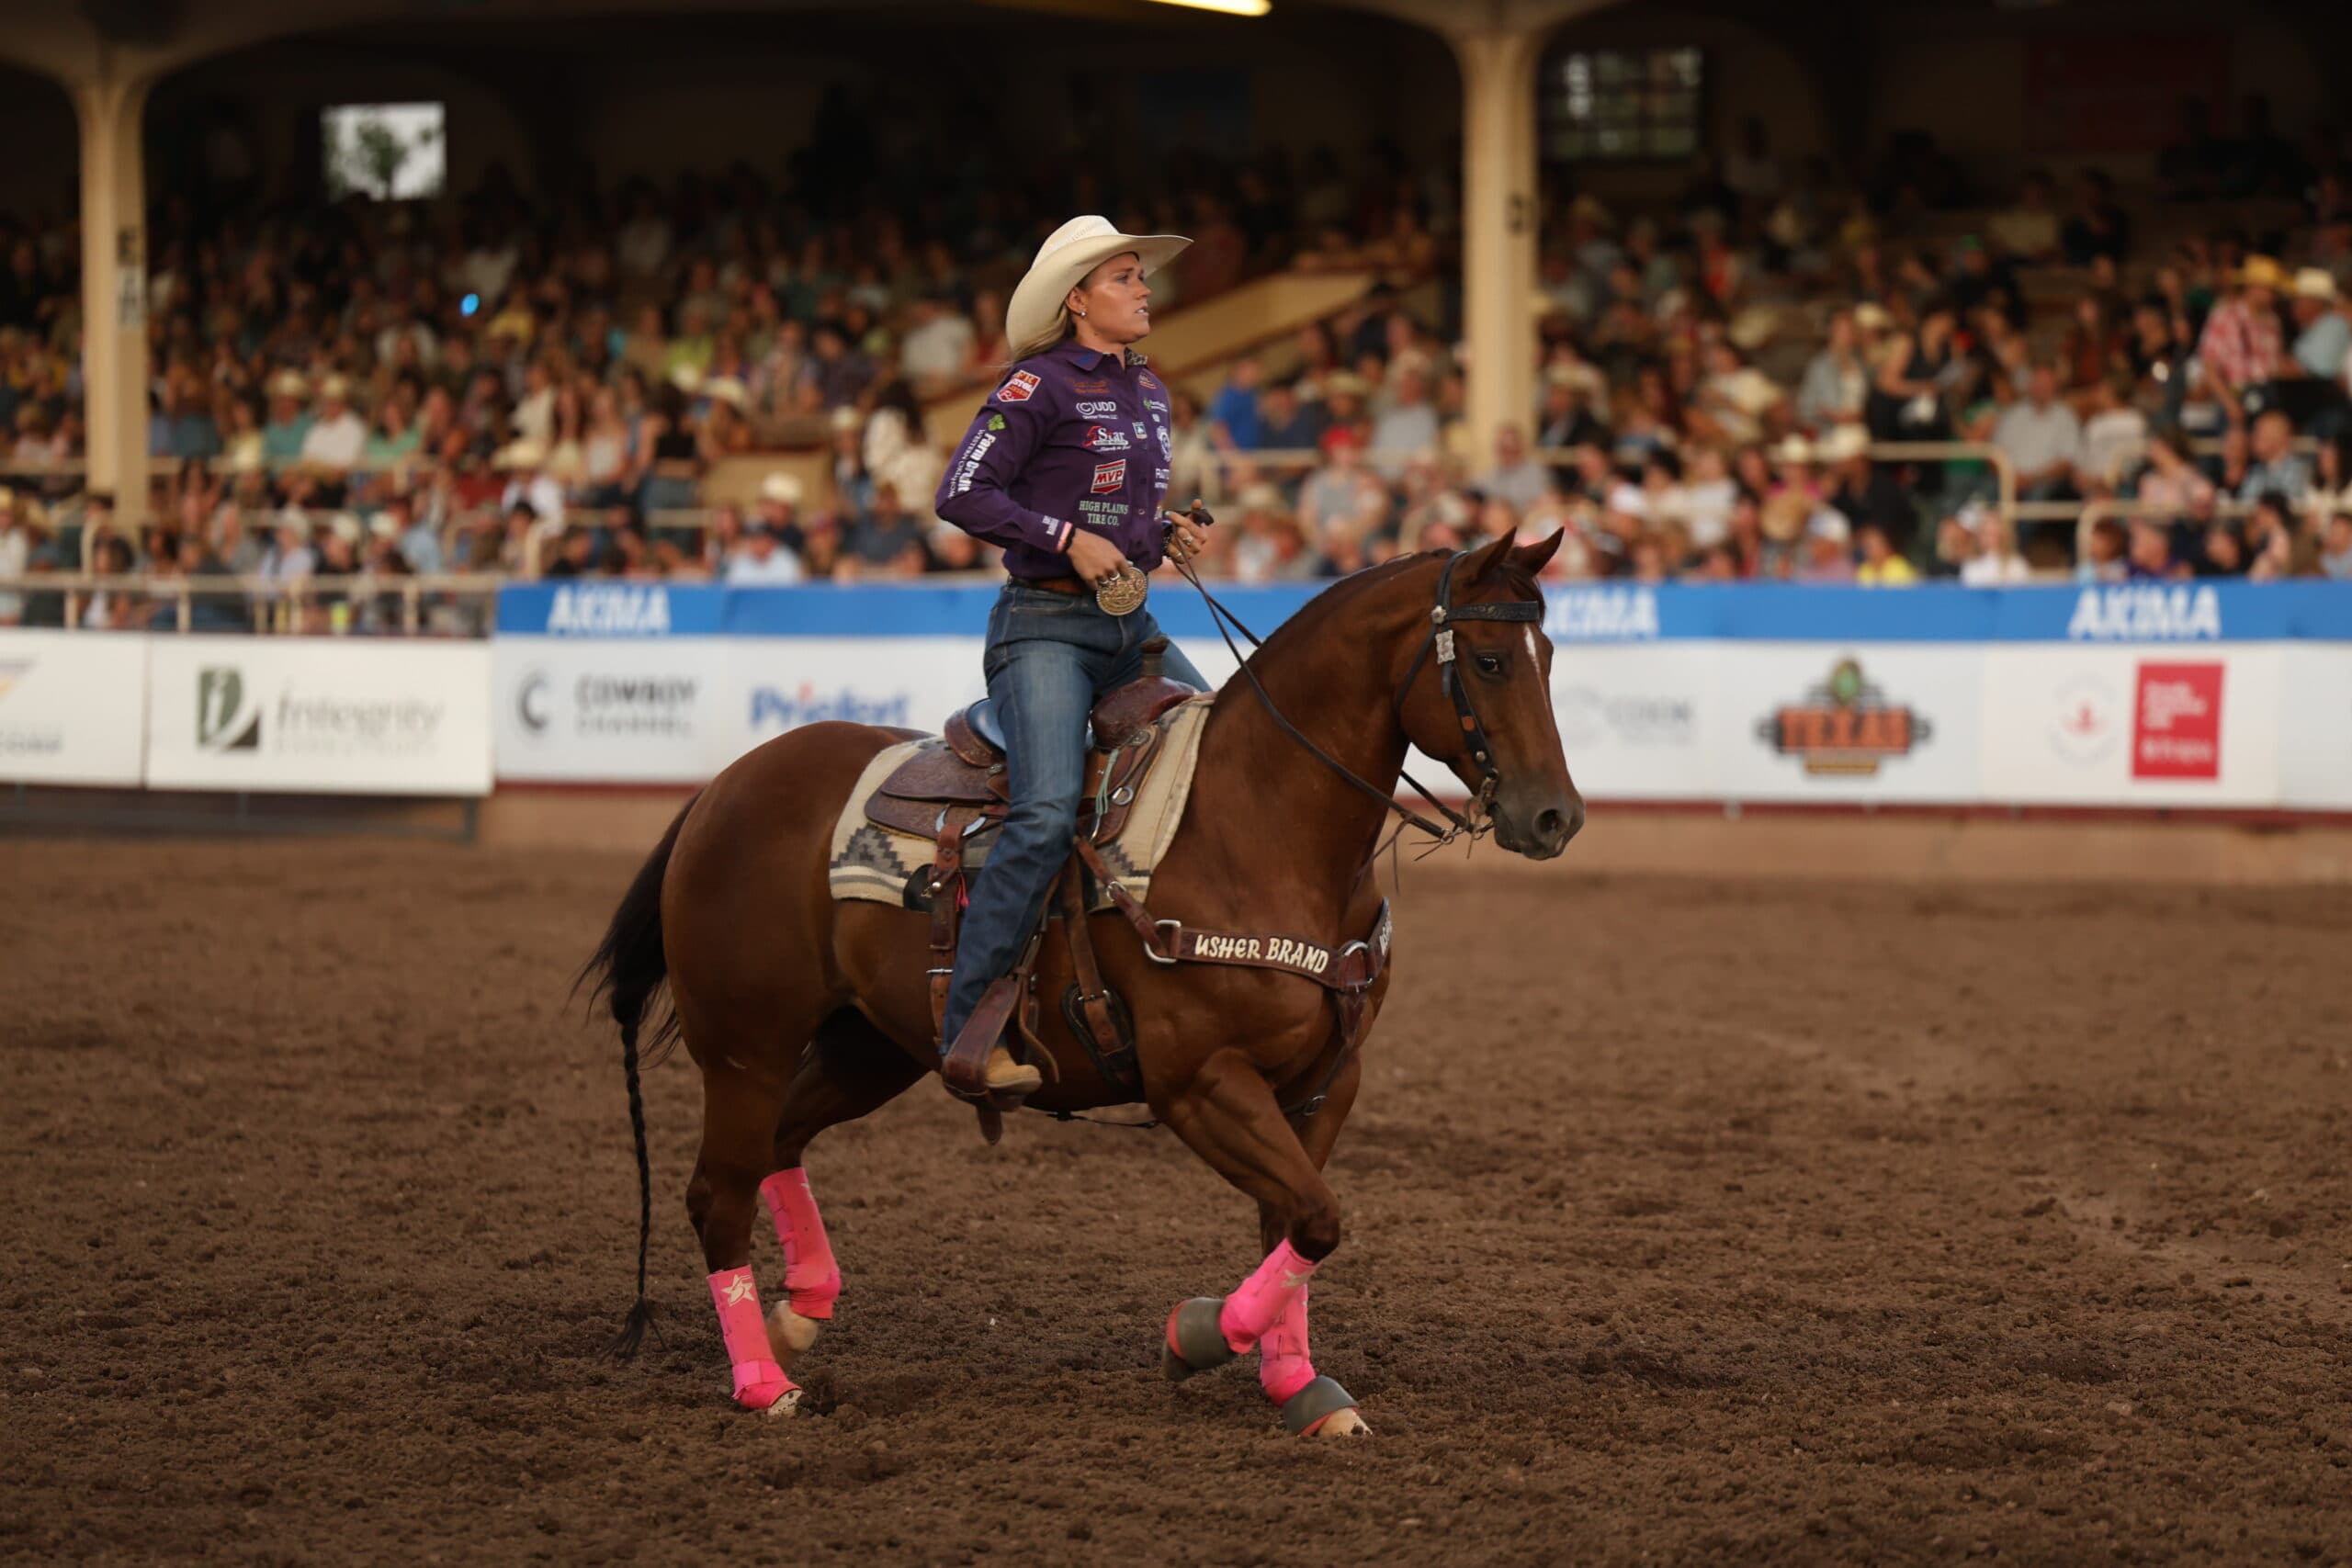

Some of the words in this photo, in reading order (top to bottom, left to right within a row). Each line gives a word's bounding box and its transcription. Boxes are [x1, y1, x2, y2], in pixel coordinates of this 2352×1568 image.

[1097, 427, 1125, 442] Star
[1094, 469, 1124, 485] MVP
[1079, 500, 1101, 512] HIGH
[1102, 502, 1129, 515] PLAINS
[1087, 513, 1106, 525] TIRE
[1107, 515, 1120, 526] CO.
[2068, 584, 2222, 639] AKIMA
[1195, 933, 1261, 959] USHER
[1265, 937, 1329, 974] BRAND
